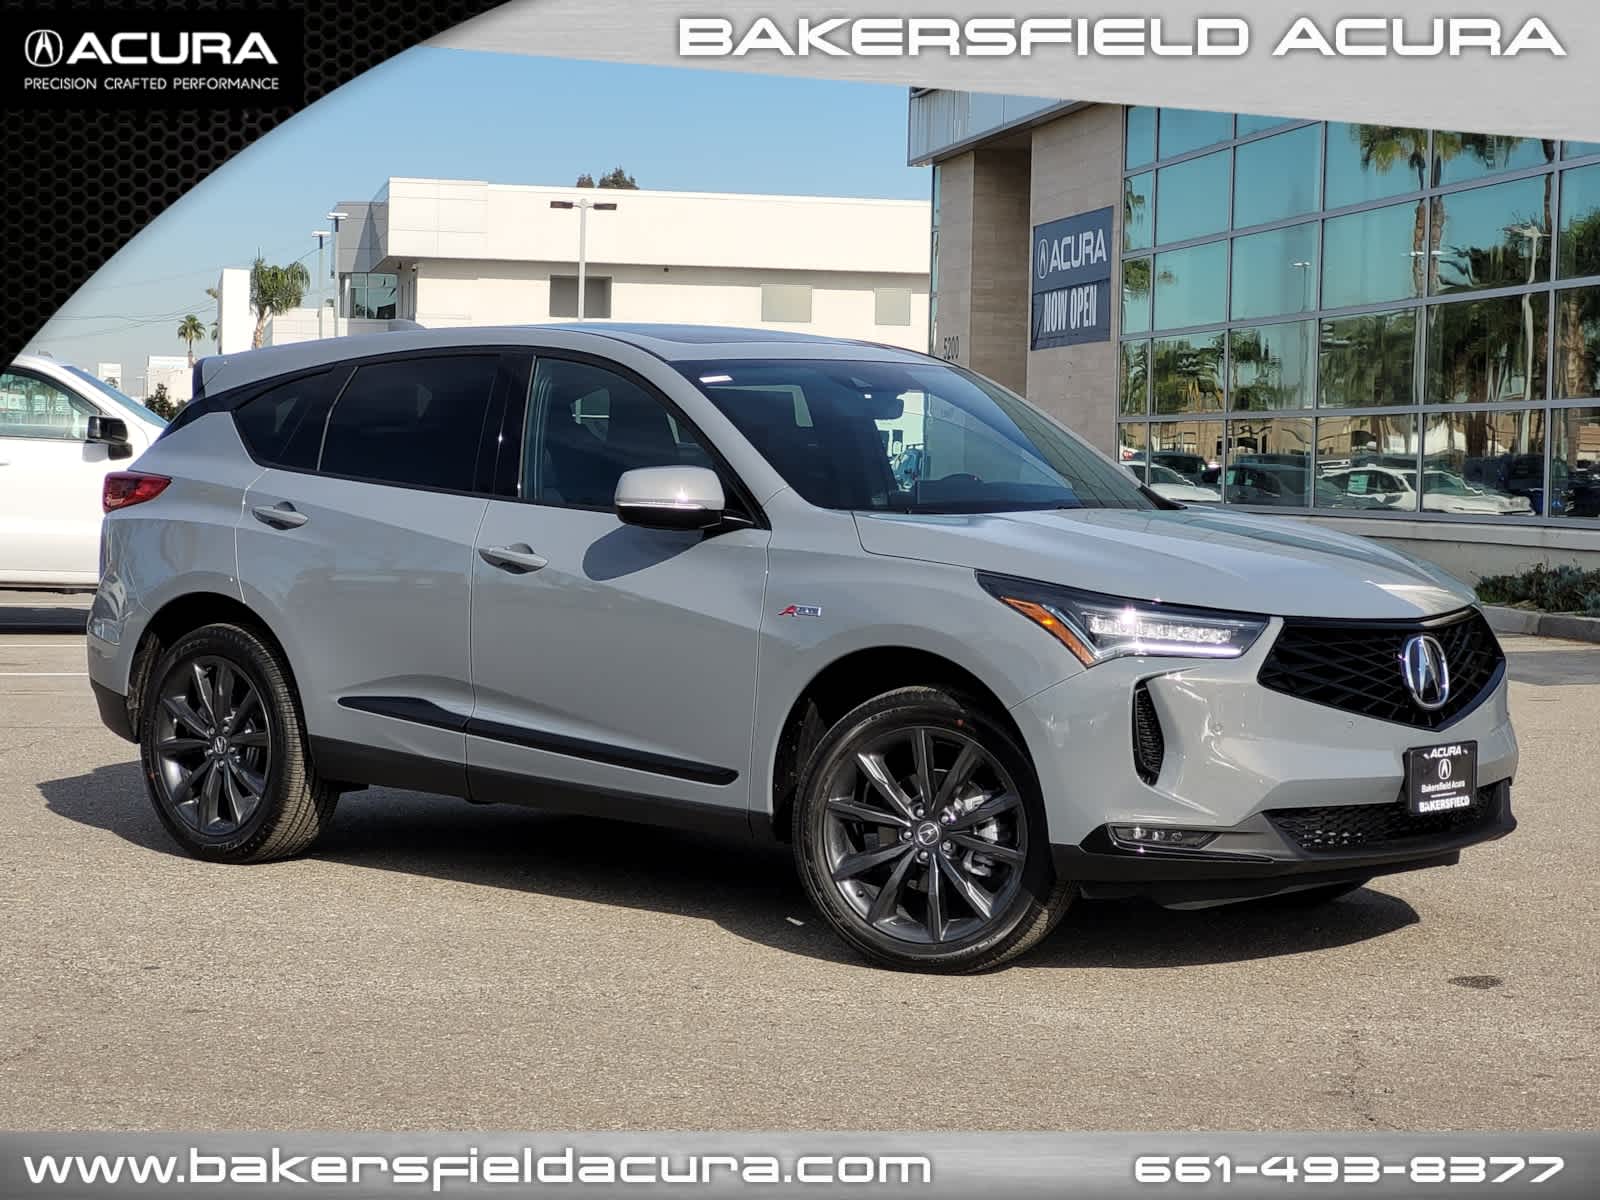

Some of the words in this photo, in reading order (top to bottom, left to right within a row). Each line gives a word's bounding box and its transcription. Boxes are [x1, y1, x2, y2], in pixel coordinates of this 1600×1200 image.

[1049, 228, 1108, 273] ACURA
[1044, 290, 1068, 333] NOW
[1070, 284, 1098, 330] OPEN
[1430, 745, 1462, 759] ACURA
[1418, 795, 1470, 813] BAKERSFIELD
